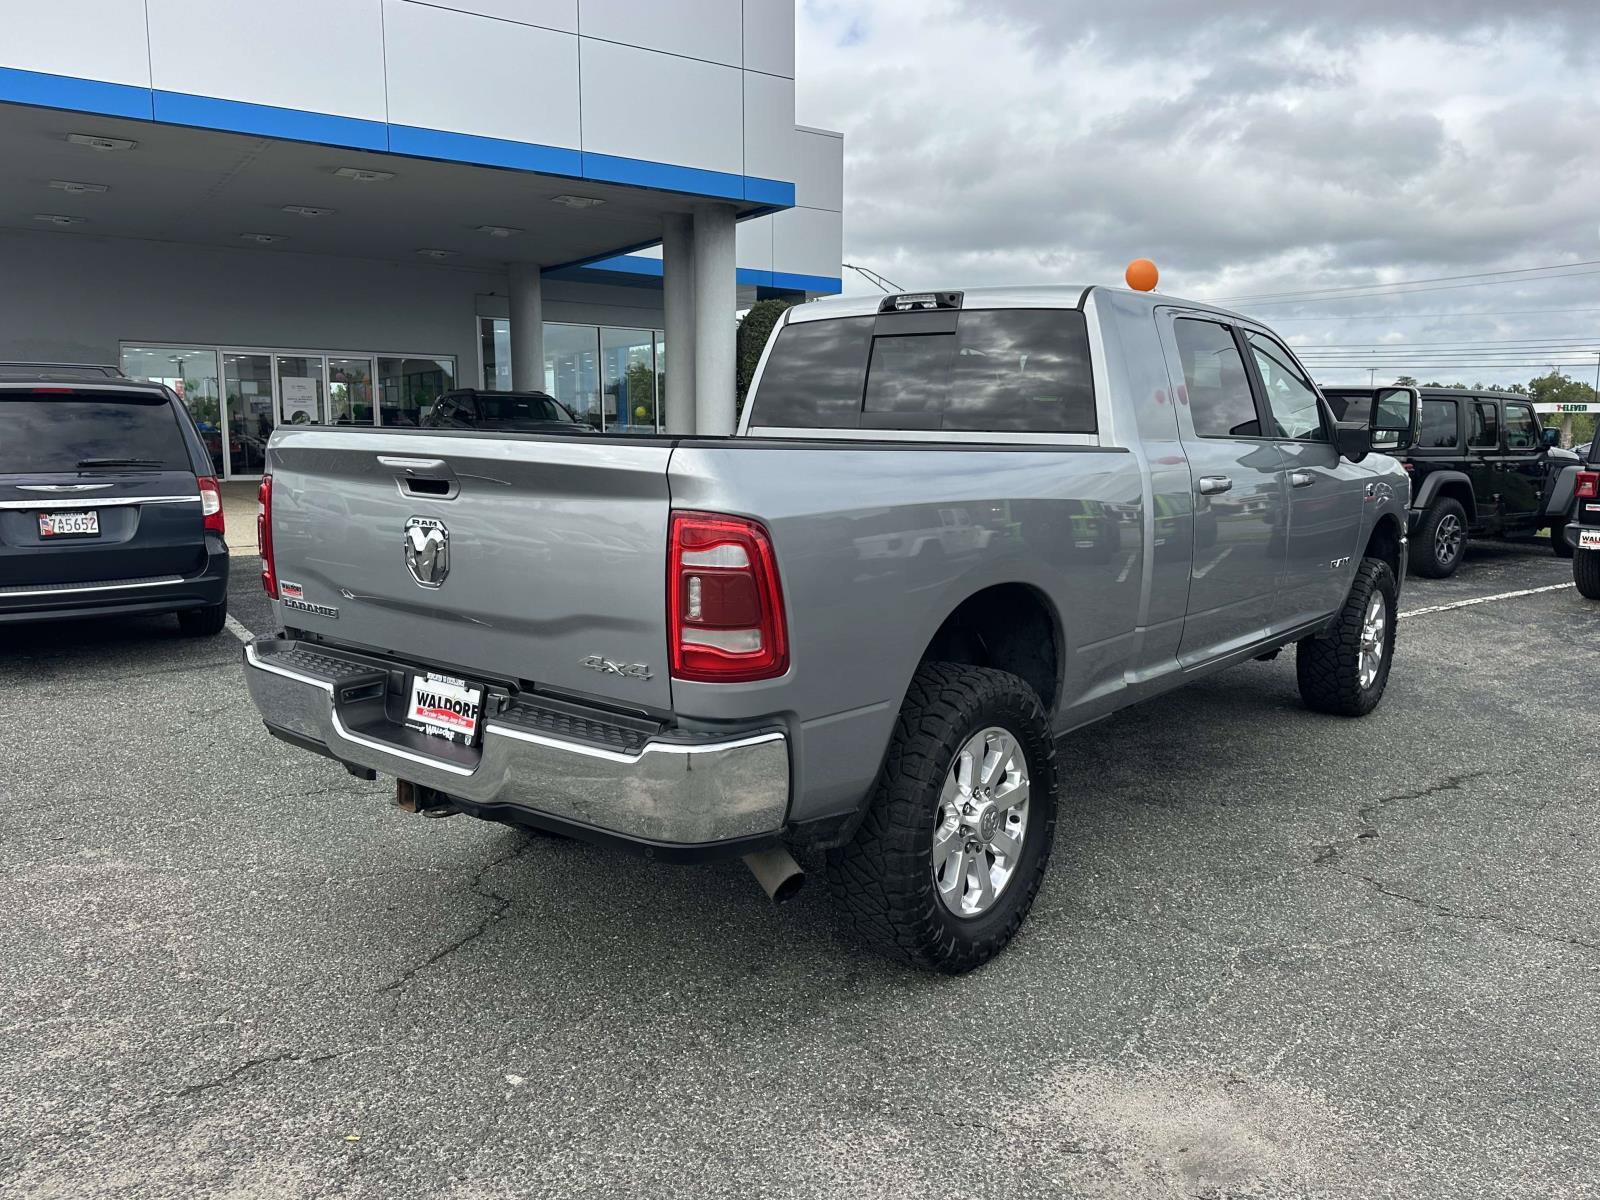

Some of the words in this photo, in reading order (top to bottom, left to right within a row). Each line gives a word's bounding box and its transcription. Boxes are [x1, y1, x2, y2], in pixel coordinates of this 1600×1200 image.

[411, 519, 438, 527] RAM
[283, 598, 339, 619] LARAMIE
[416, 690, 480, 720] WALDORF
